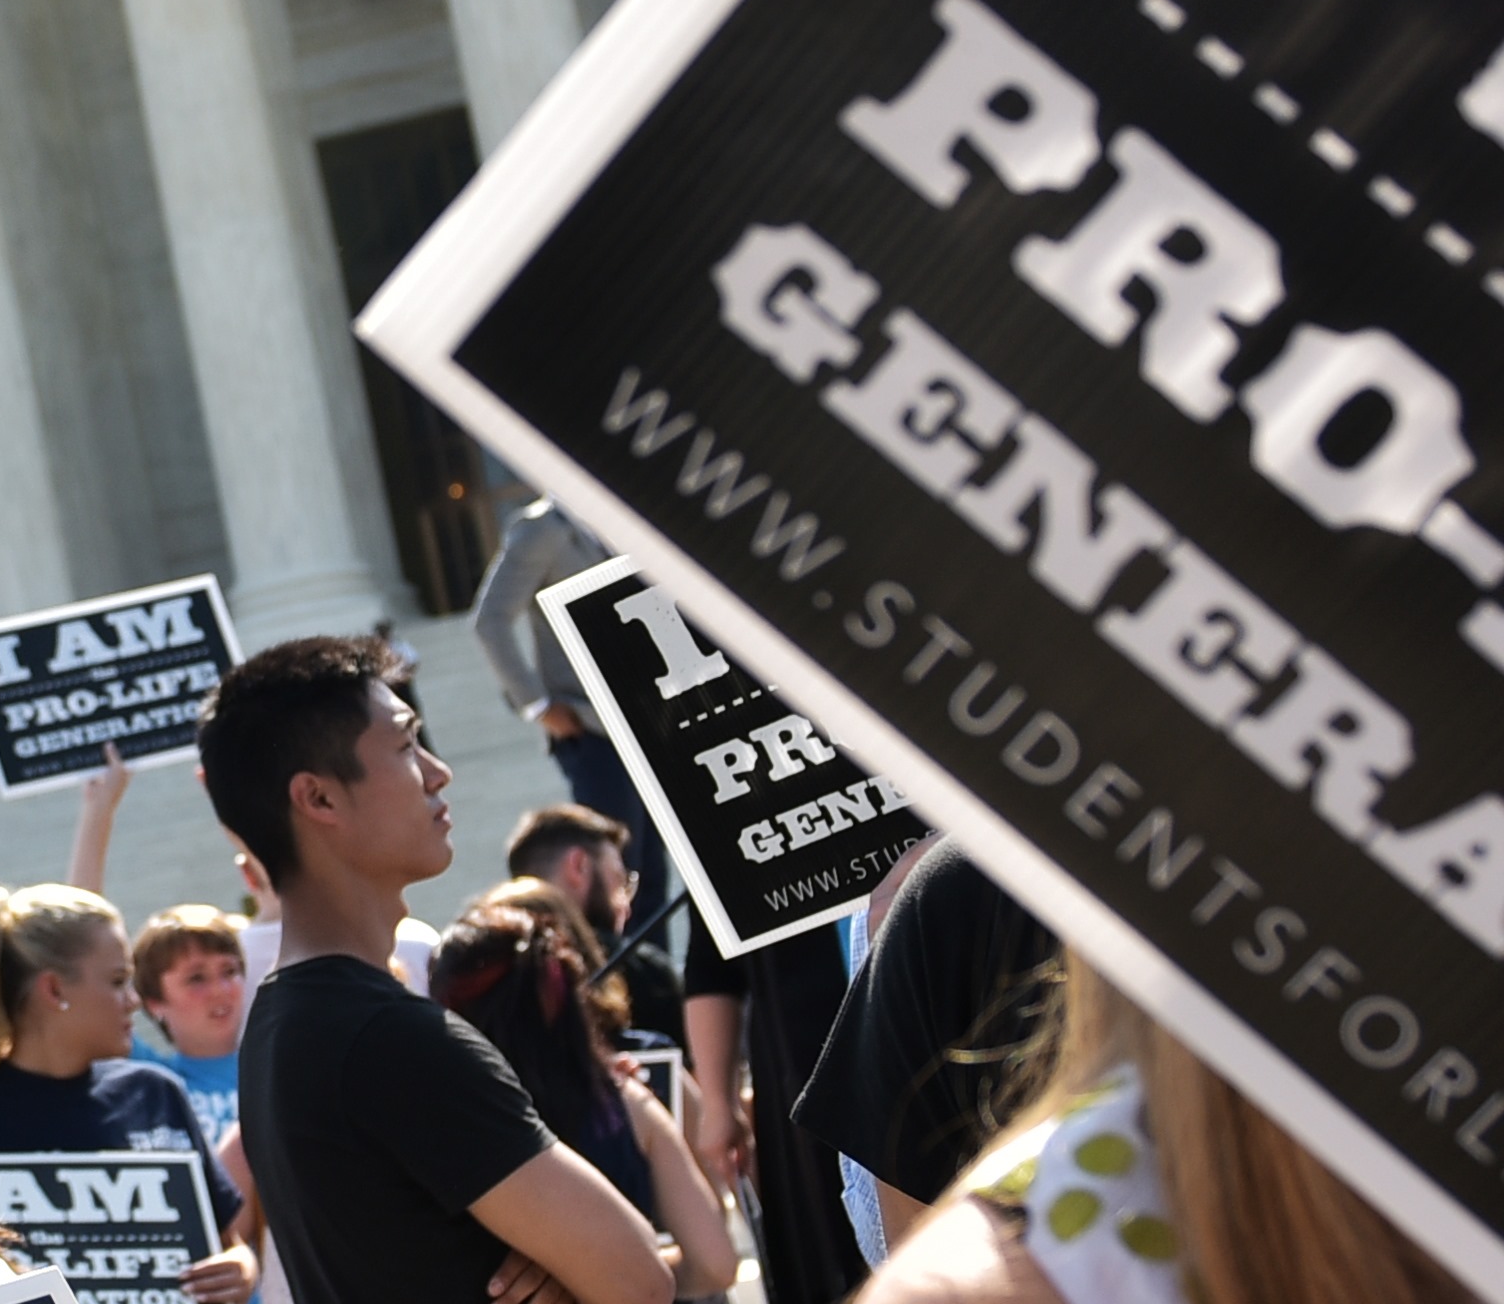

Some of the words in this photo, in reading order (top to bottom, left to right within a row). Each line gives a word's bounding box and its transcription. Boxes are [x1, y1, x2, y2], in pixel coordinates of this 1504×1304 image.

[47, 596, 206, 674] AM
[613, 584, 731, 700] I
[2, 660, 221, 732] PRO-LIFE
[29, 1230, 65, 1245] the
